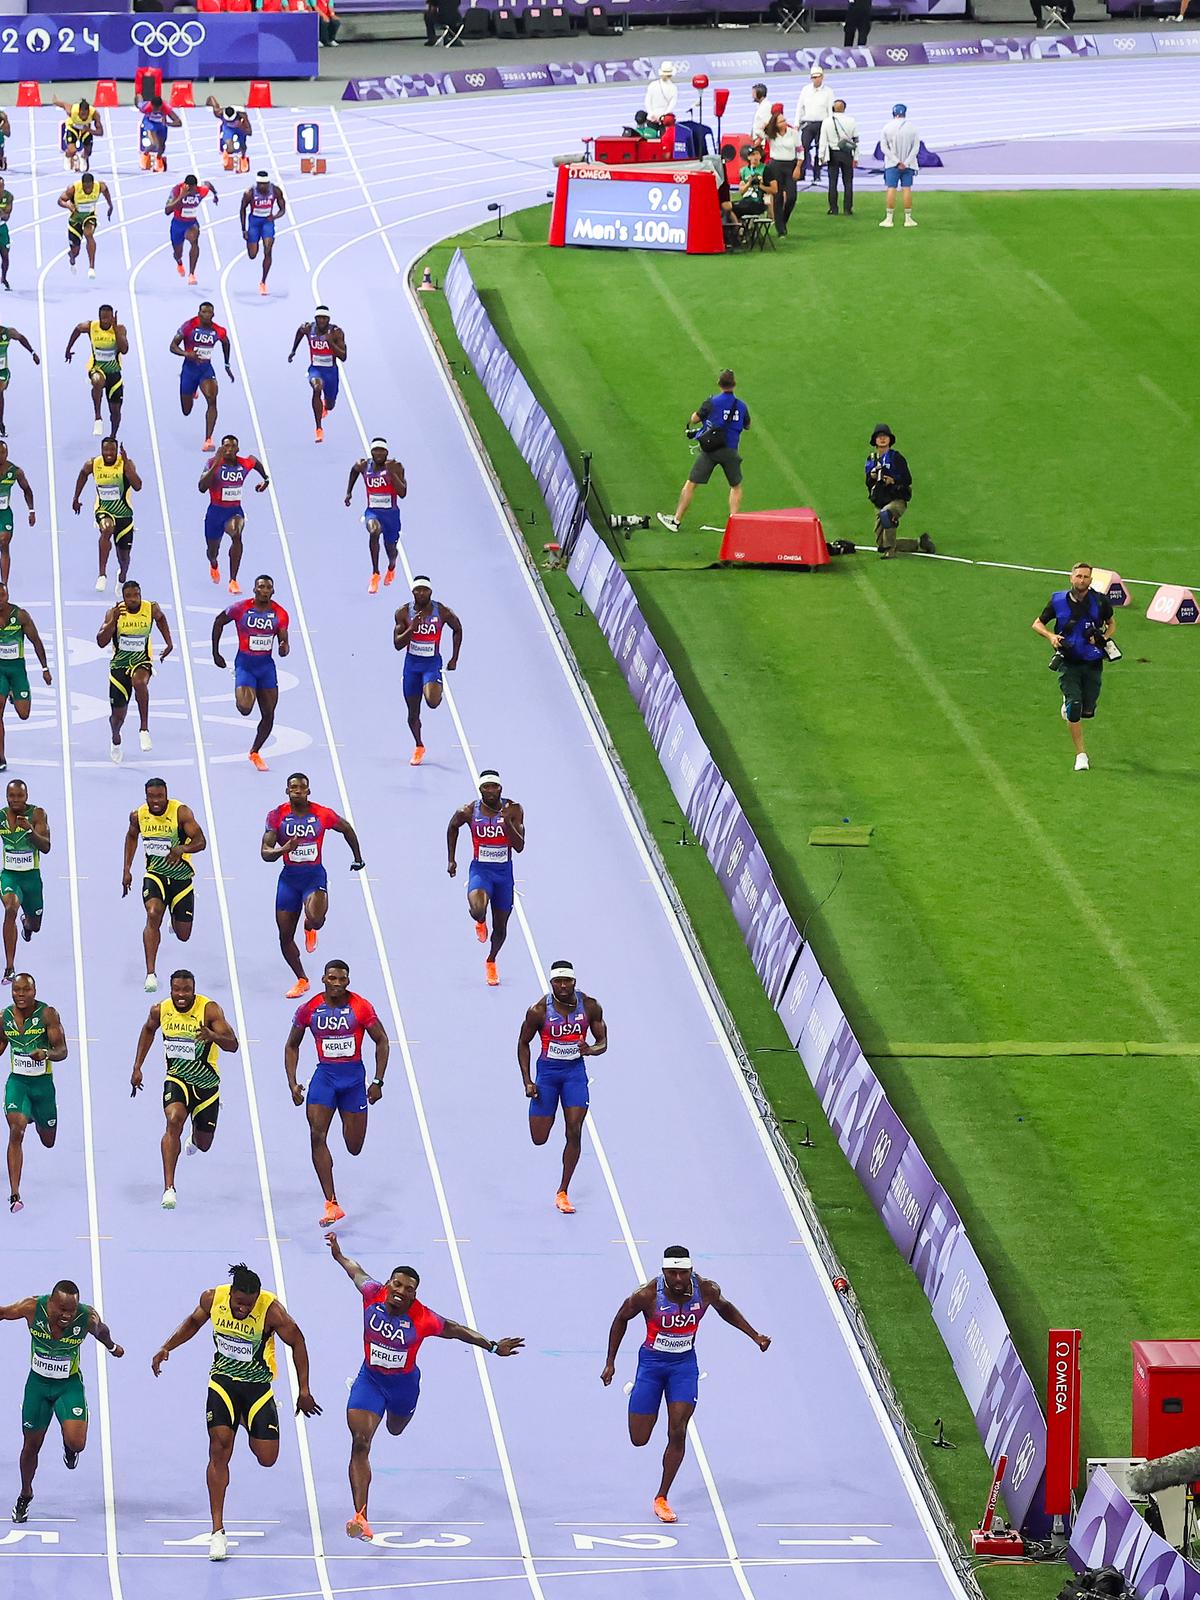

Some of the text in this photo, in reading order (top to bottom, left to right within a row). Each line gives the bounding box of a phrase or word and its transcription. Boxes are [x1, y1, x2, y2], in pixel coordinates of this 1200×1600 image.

[2, 26, 100, 55] 2024
[301, 127, 315, 150] 1
[579, 169, 611, 181] OMEGA
[648, 187, 682, 212] 9.6
[573, 217, 686, 244] Men's 100m
[195, 332, 214, 344] USA
[311, 339, 330, 349] USA
[221, 470, 243, 482] USA
[366, 477, 387, 488] USA
[246, 618, 273, 630] USA
[143, 825, 173, 833] JAMAICA
[285, 823, 316, 837] USA
[476, 825, 505, 838] USA
[165, 1023, 197, 1032] JAMAICA
[317, 1016, 349, 1030] USA
[551, 1023, 581, 1038] USA
[324, 1042, 352, 1051] KERLEY
[215, 1318, 255, 1336] JAMAICA
[661, 1313, 697, 1329] USA
[369, 1313, 405, 1345] USA
[371, 1349, 405, 1363] KERLEY
[1055, 1361, 1069, 1414] OMEGA
[163, 1531, 265, 1547] 4
[369, 1531, 472, 1549] 3
[571, 1533, 680, 1550] 2
[778, 1536, 882, 1546] 1
